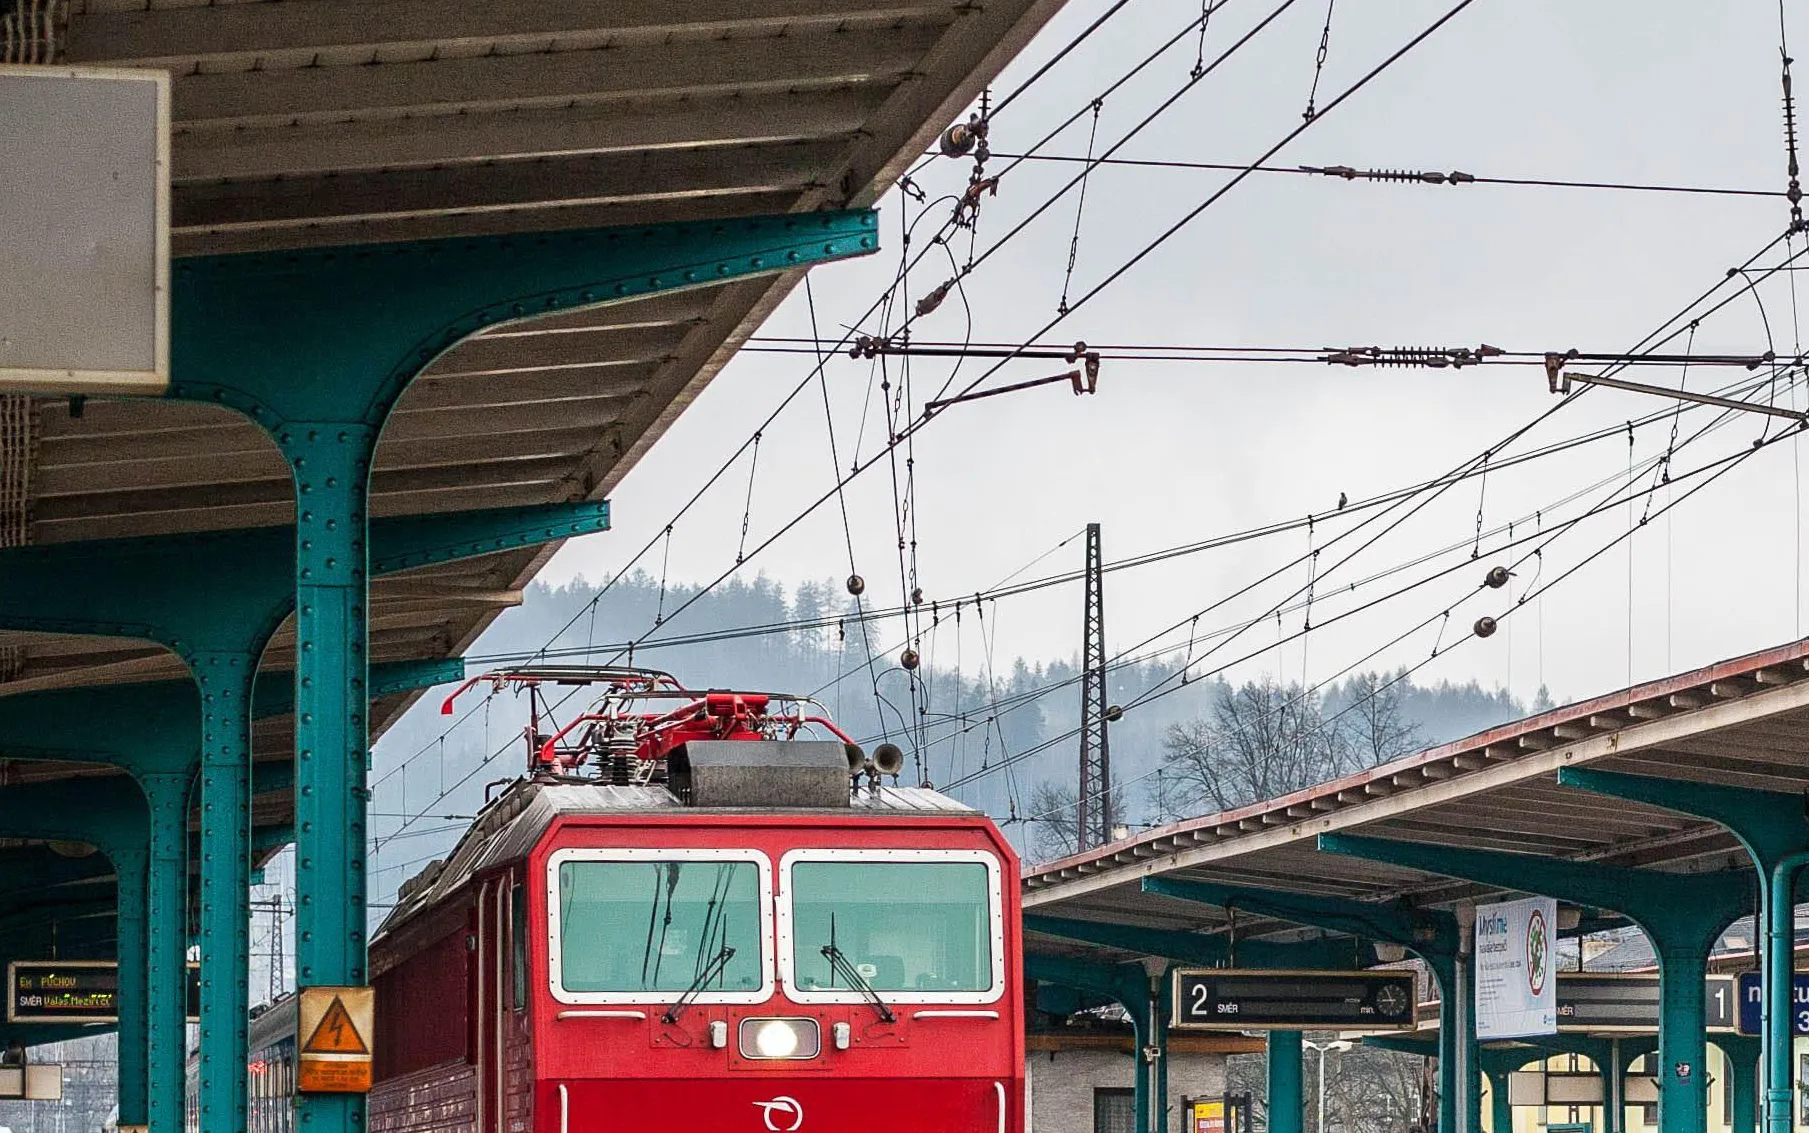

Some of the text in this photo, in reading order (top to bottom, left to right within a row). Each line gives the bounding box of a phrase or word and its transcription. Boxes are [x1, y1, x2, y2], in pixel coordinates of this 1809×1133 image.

[1191, 983, 1208, 1015] 2
[1217, 1002, 1239, 1014] SMĚR
[1714, 988, 1725, 1019] 1
[1556, 1004, 1574, 1016] MĚR
